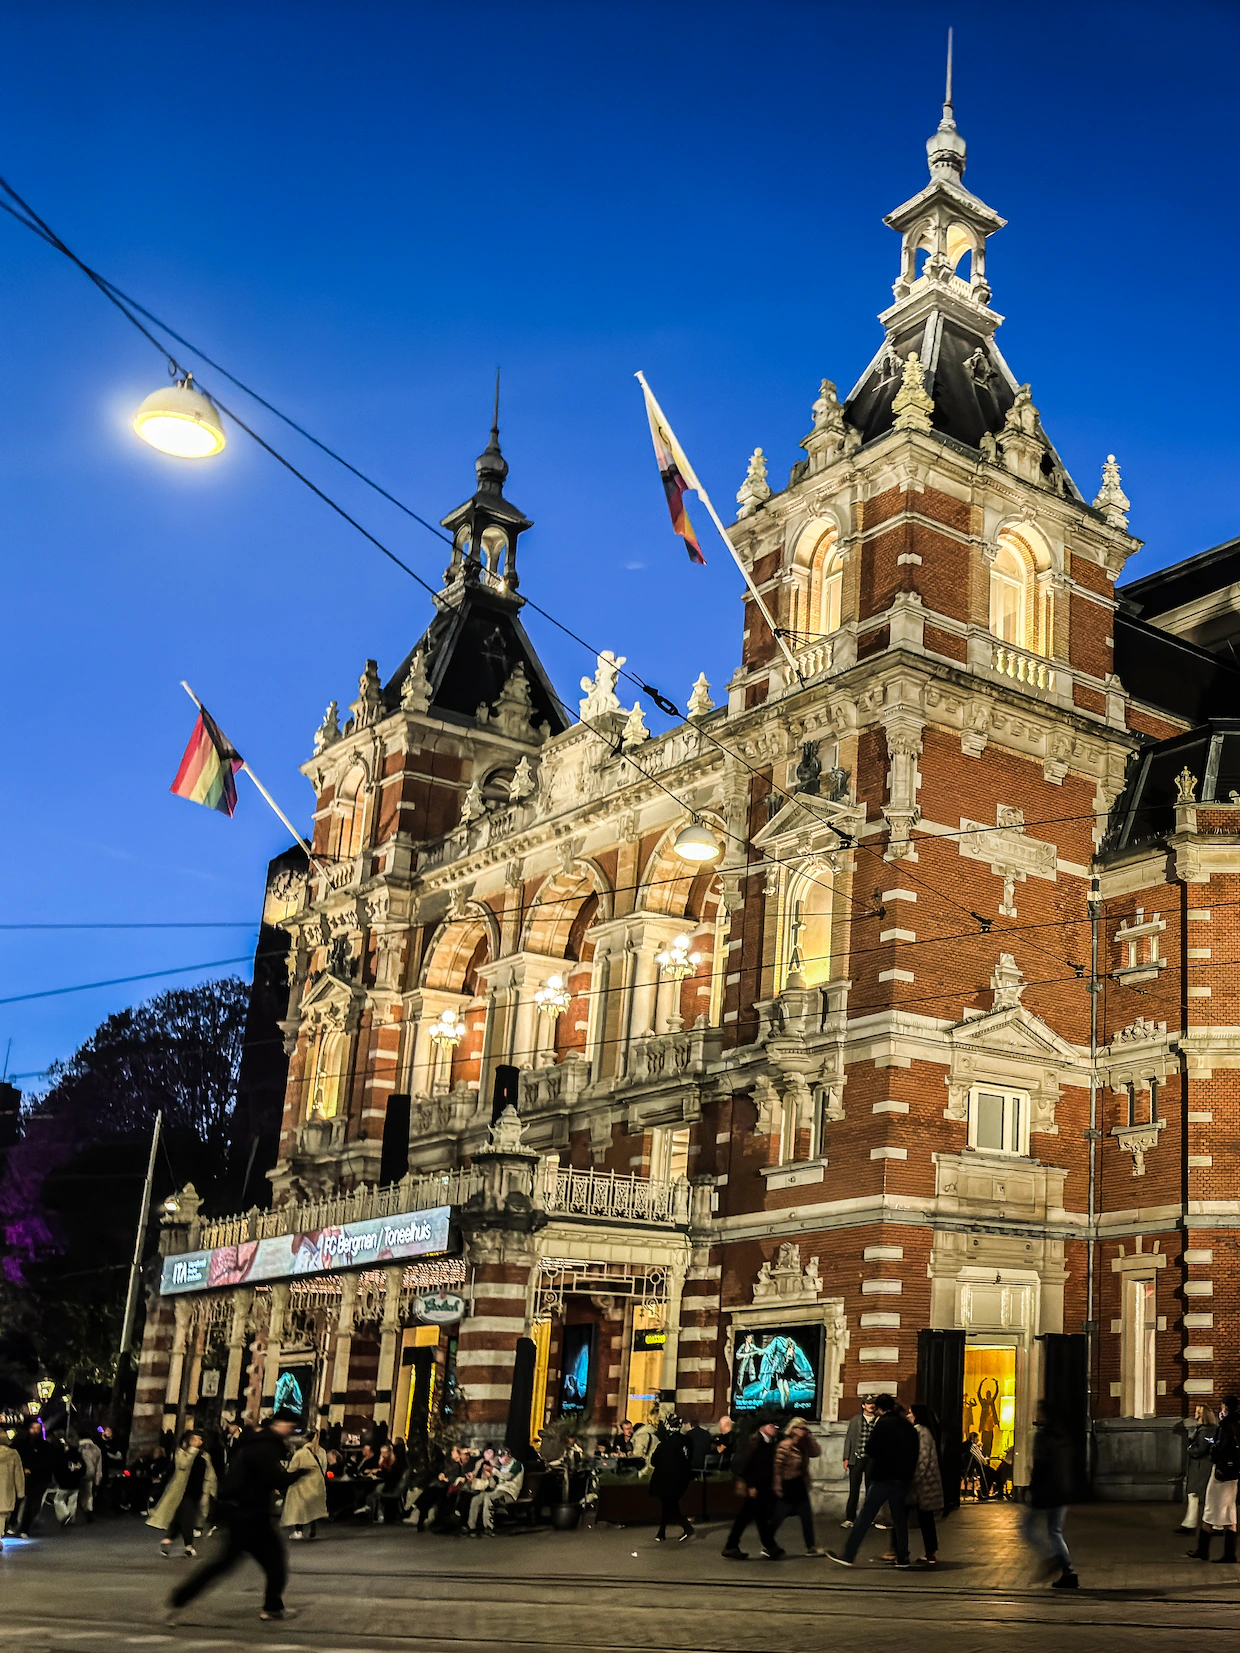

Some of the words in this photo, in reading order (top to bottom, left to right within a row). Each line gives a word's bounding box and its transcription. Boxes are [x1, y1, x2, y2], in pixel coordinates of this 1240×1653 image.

[323, 1234, 337, 1257] FC
[337, 1232, 377, 1257] Bergman
[384, 1219, 432, 1247] Toneelhuis
[172, 1261, 188, 1285] ITA
